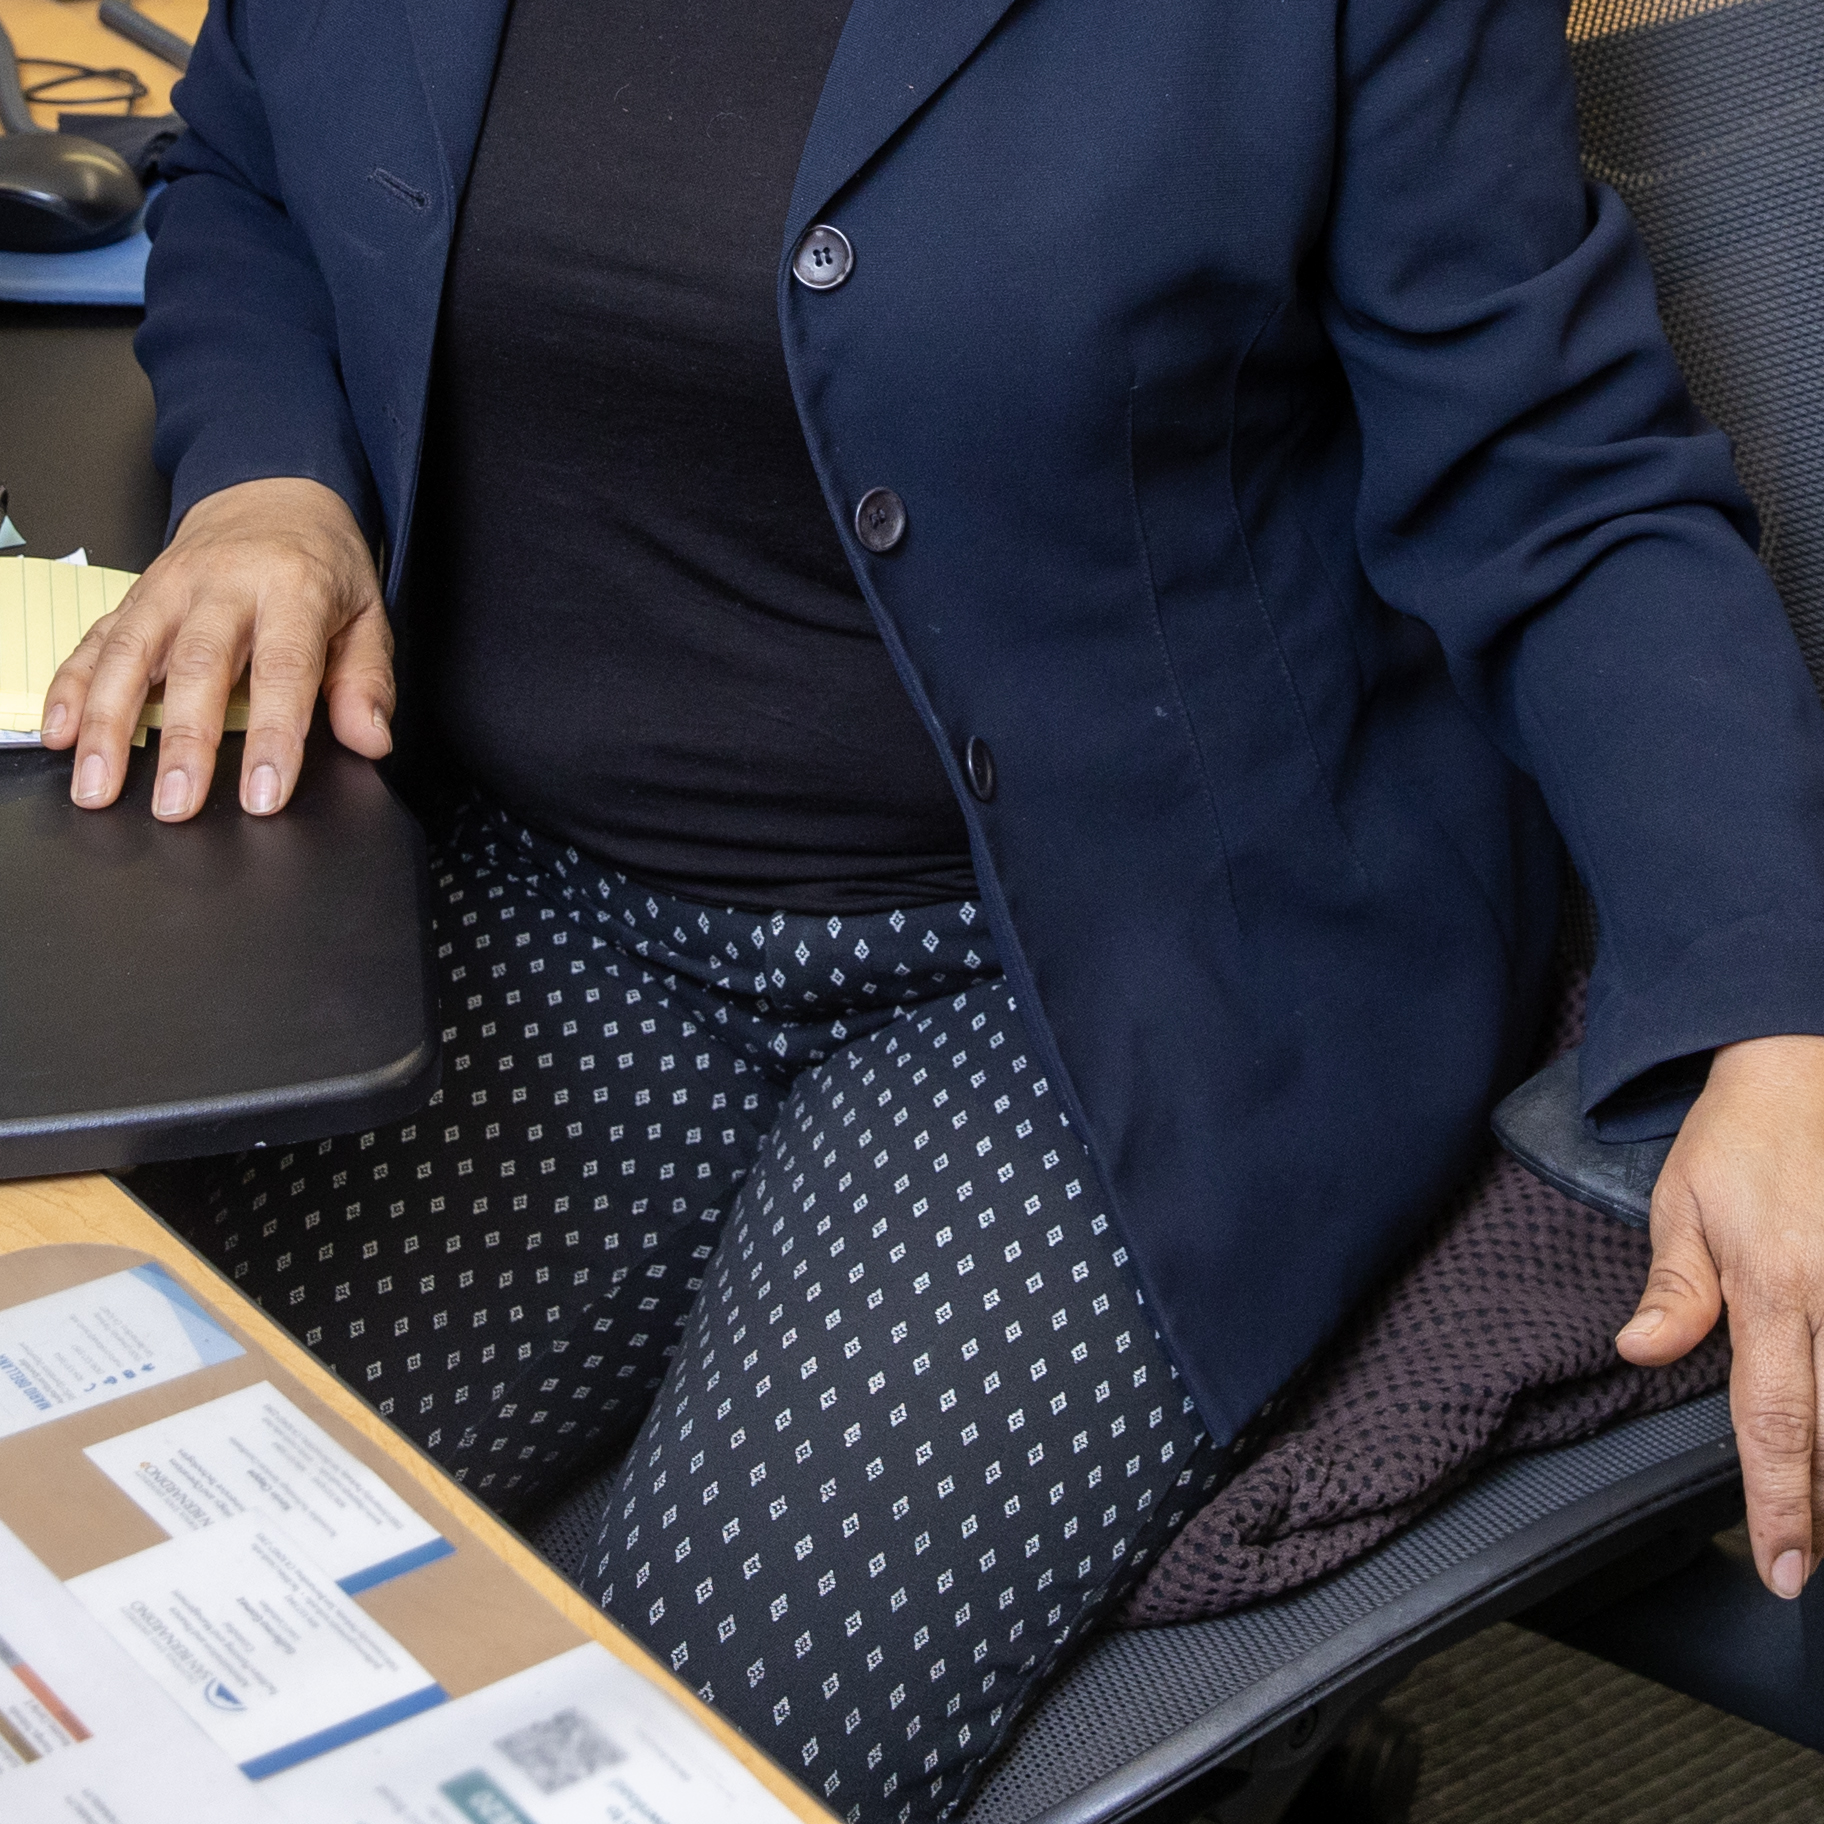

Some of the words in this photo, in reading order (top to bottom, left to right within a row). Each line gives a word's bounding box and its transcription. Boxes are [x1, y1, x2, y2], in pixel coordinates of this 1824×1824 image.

[21, 1386, 54, 1410] MARIO
[175, 1447, 219, 1484] Technologies
[142, 1464, 207, 1519] BERNARDINO
[168, 1587, 217, 1631] Management
[232, 1595, 266, 1623] Gomez
[126, 1599, 195, 1661] BERNARDINO
[185, 1658, 214, 1680] SAN
